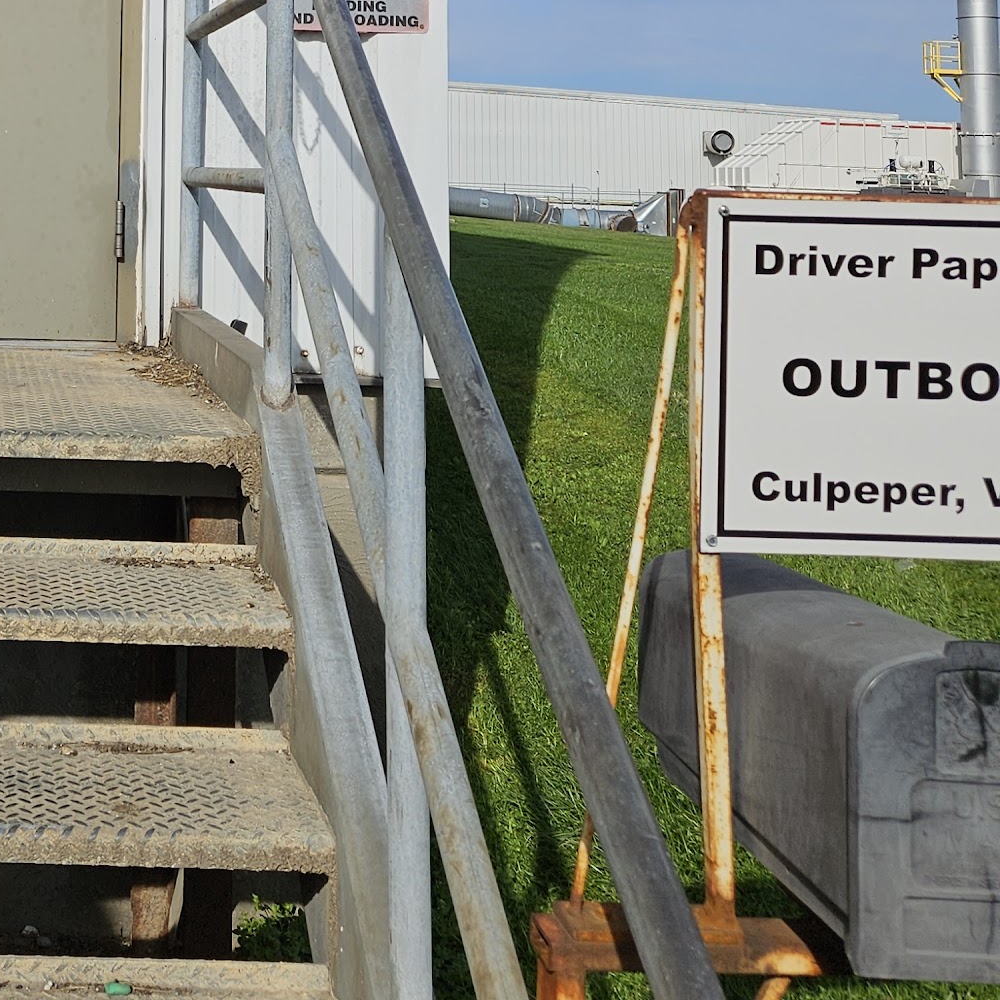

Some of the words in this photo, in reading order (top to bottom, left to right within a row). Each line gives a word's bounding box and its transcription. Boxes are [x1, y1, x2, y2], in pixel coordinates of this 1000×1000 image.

[294, 13, 315, 25] ND
[354, 14, 419, 27] OADING
[346, 0, 387, 13] DING
[755, 244, 895, 278] Driver
[912, 248, 998, 289] Pap
[782, 357, 1000, 402] OUTBO
[752, 470, 966, 514] Culpeper,
